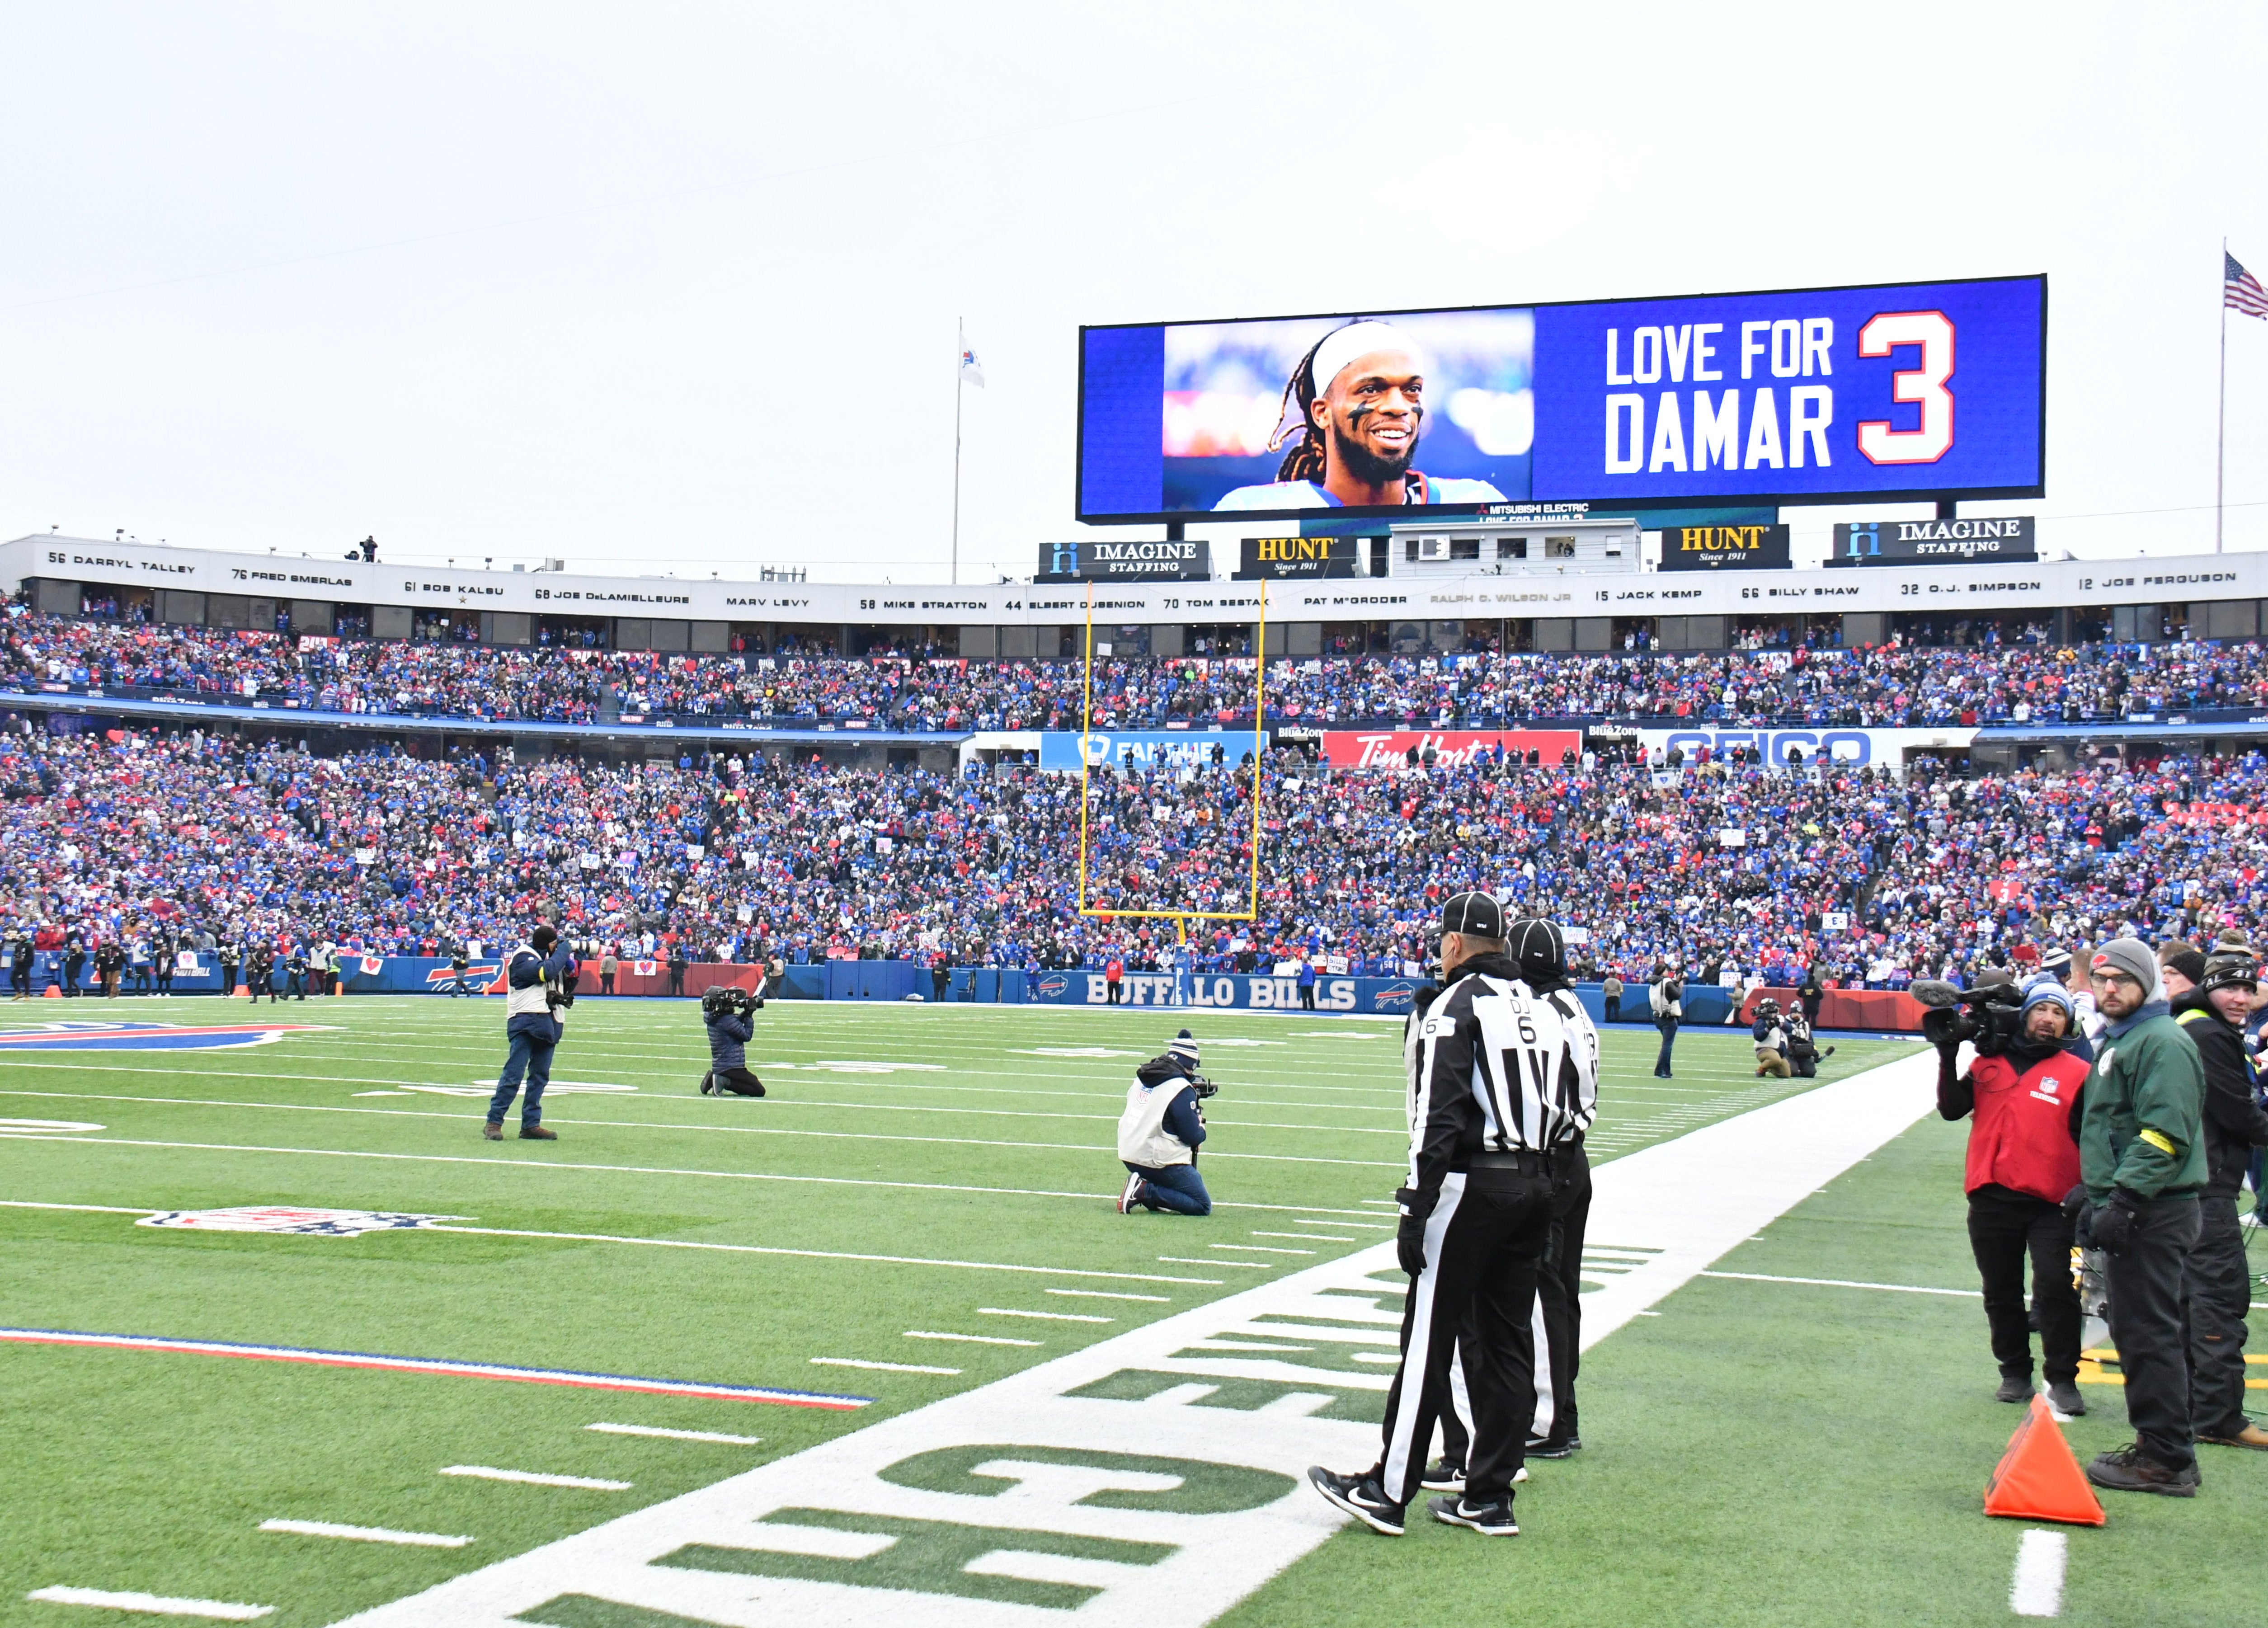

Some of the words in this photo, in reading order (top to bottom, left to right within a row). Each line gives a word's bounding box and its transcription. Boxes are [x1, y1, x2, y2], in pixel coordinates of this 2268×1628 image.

[1607, 323, 1722, 385] LOVE
[1741, 317, 1833, 379] FOR
[1858, 310, 1955, 465] 3
[1605, 385, 1832, 474] DAMAR
[1490, 504, 1541, 515] MITSUBISHI
[1543, 503, 1589, 513] ELECTRIC
[1898, 520, 2020, 541] IMAGINE
[1680, 526, 1765, 551] HUNT
[1094, 542, 1196, 560] IMAGINE
[1257, 538, 1334, 560] HUNT
[1916, 541, 2000, 554] STAFFING
[48, 552, 66, 564] 56
[74, 555, 133, 568] DARRYL
[141, 562, 195, 574] TALLEY
[1699, 553, 1724, 562] Since
[1727, 552, 1746, 561] 1911
[1109, 562, 1180, 572] STAFFING
[1275, 563, 1297, 571] Since
[1300, 562, 1317, 570] 1911
[231, 569, 247, 580] 76
[252, 572, 286, 581] FRED
[291, 575, 352, 586] SMERLAS
[2078, 579, 2093, 590] 12
[2101, 577, 2135, 588] JOE
[2143, 572, 2236, 585] FERGUSON
[405, 582, 416, 592] 61
[458, 586, 503, 595] KALSU
[535, 589, 550, 599] 68
[1741, 588, 1760, 598] 66
[1769, 587, 1807, 597] BILLY
[1814, 586, 1859, 596] SHAW
[1901, 584, 1919, 595] 32
[1929, 584, 1961, 593] O.J.
[1969, 581, 2041, 592] SIMPSON
[727, 598, 767, 606] MARV
[1430, 594, 1473, 603] RALPH
[1479, 594, 1492, 602] C.
[1495, 593, 1548, 602] WILSON
[1553, 593, 1571, 602] JR
[1595, 591, 1608, 601] 15
[1617, 591, 1654, 600] JACK
[1661, 590, 1702, 598] KEMP
[860, 600, 875, 609] 58
[1006, 601, 1022, 611] 44
[1164, 599, 1179, 609] 70
[1667, 732, 1870, 768] GEICO
[1510, 999, 1530, 1014] DJ
[1426, 1018, 1436, 1034] 6
[1518, 1016, 1537, 1044] 6
[2040, 1083, 2056, 1092] NFL
[1139, 1092, 1149, 1102] NFL
[2029, 1091, 2060, 1106] TELEVISION
